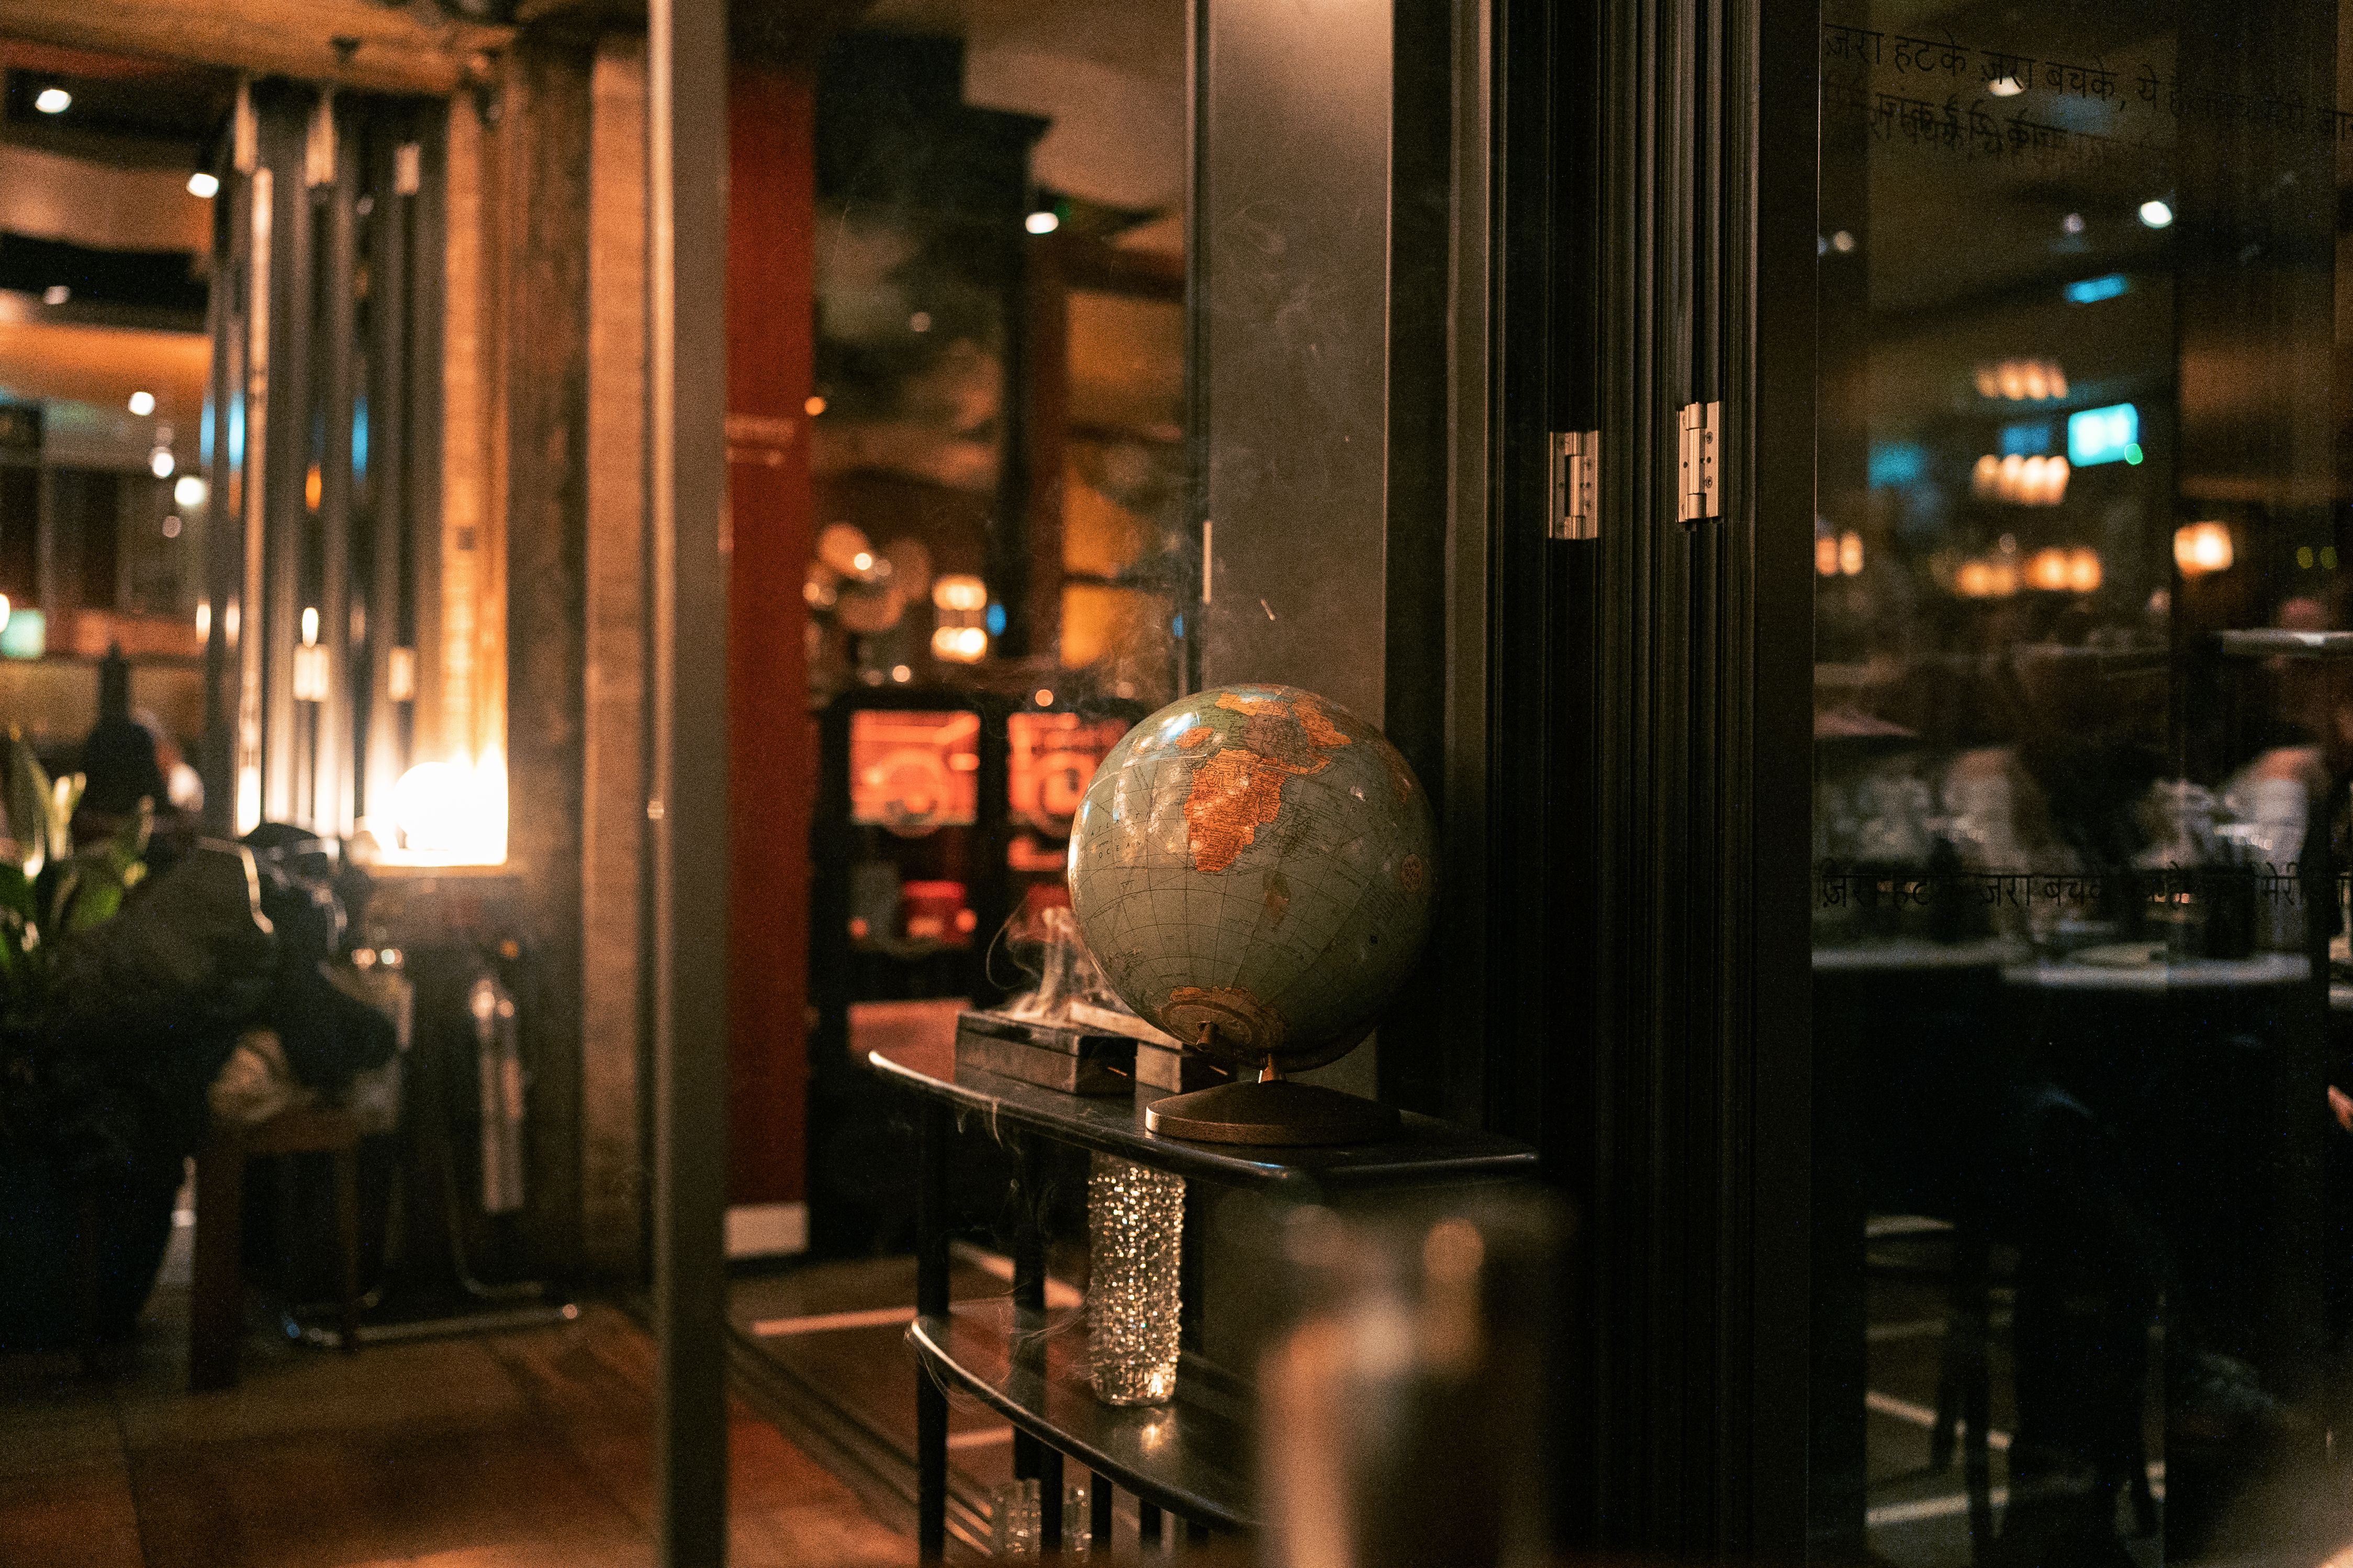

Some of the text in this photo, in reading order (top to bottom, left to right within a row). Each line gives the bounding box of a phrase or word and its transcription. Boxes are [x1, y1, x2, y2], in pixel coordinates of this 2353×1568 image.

[1895, 27, 1970, 77] हटके
[2136, 63, 2159, 110] ये
[1099, 841, 1141, 859] OCEAN
